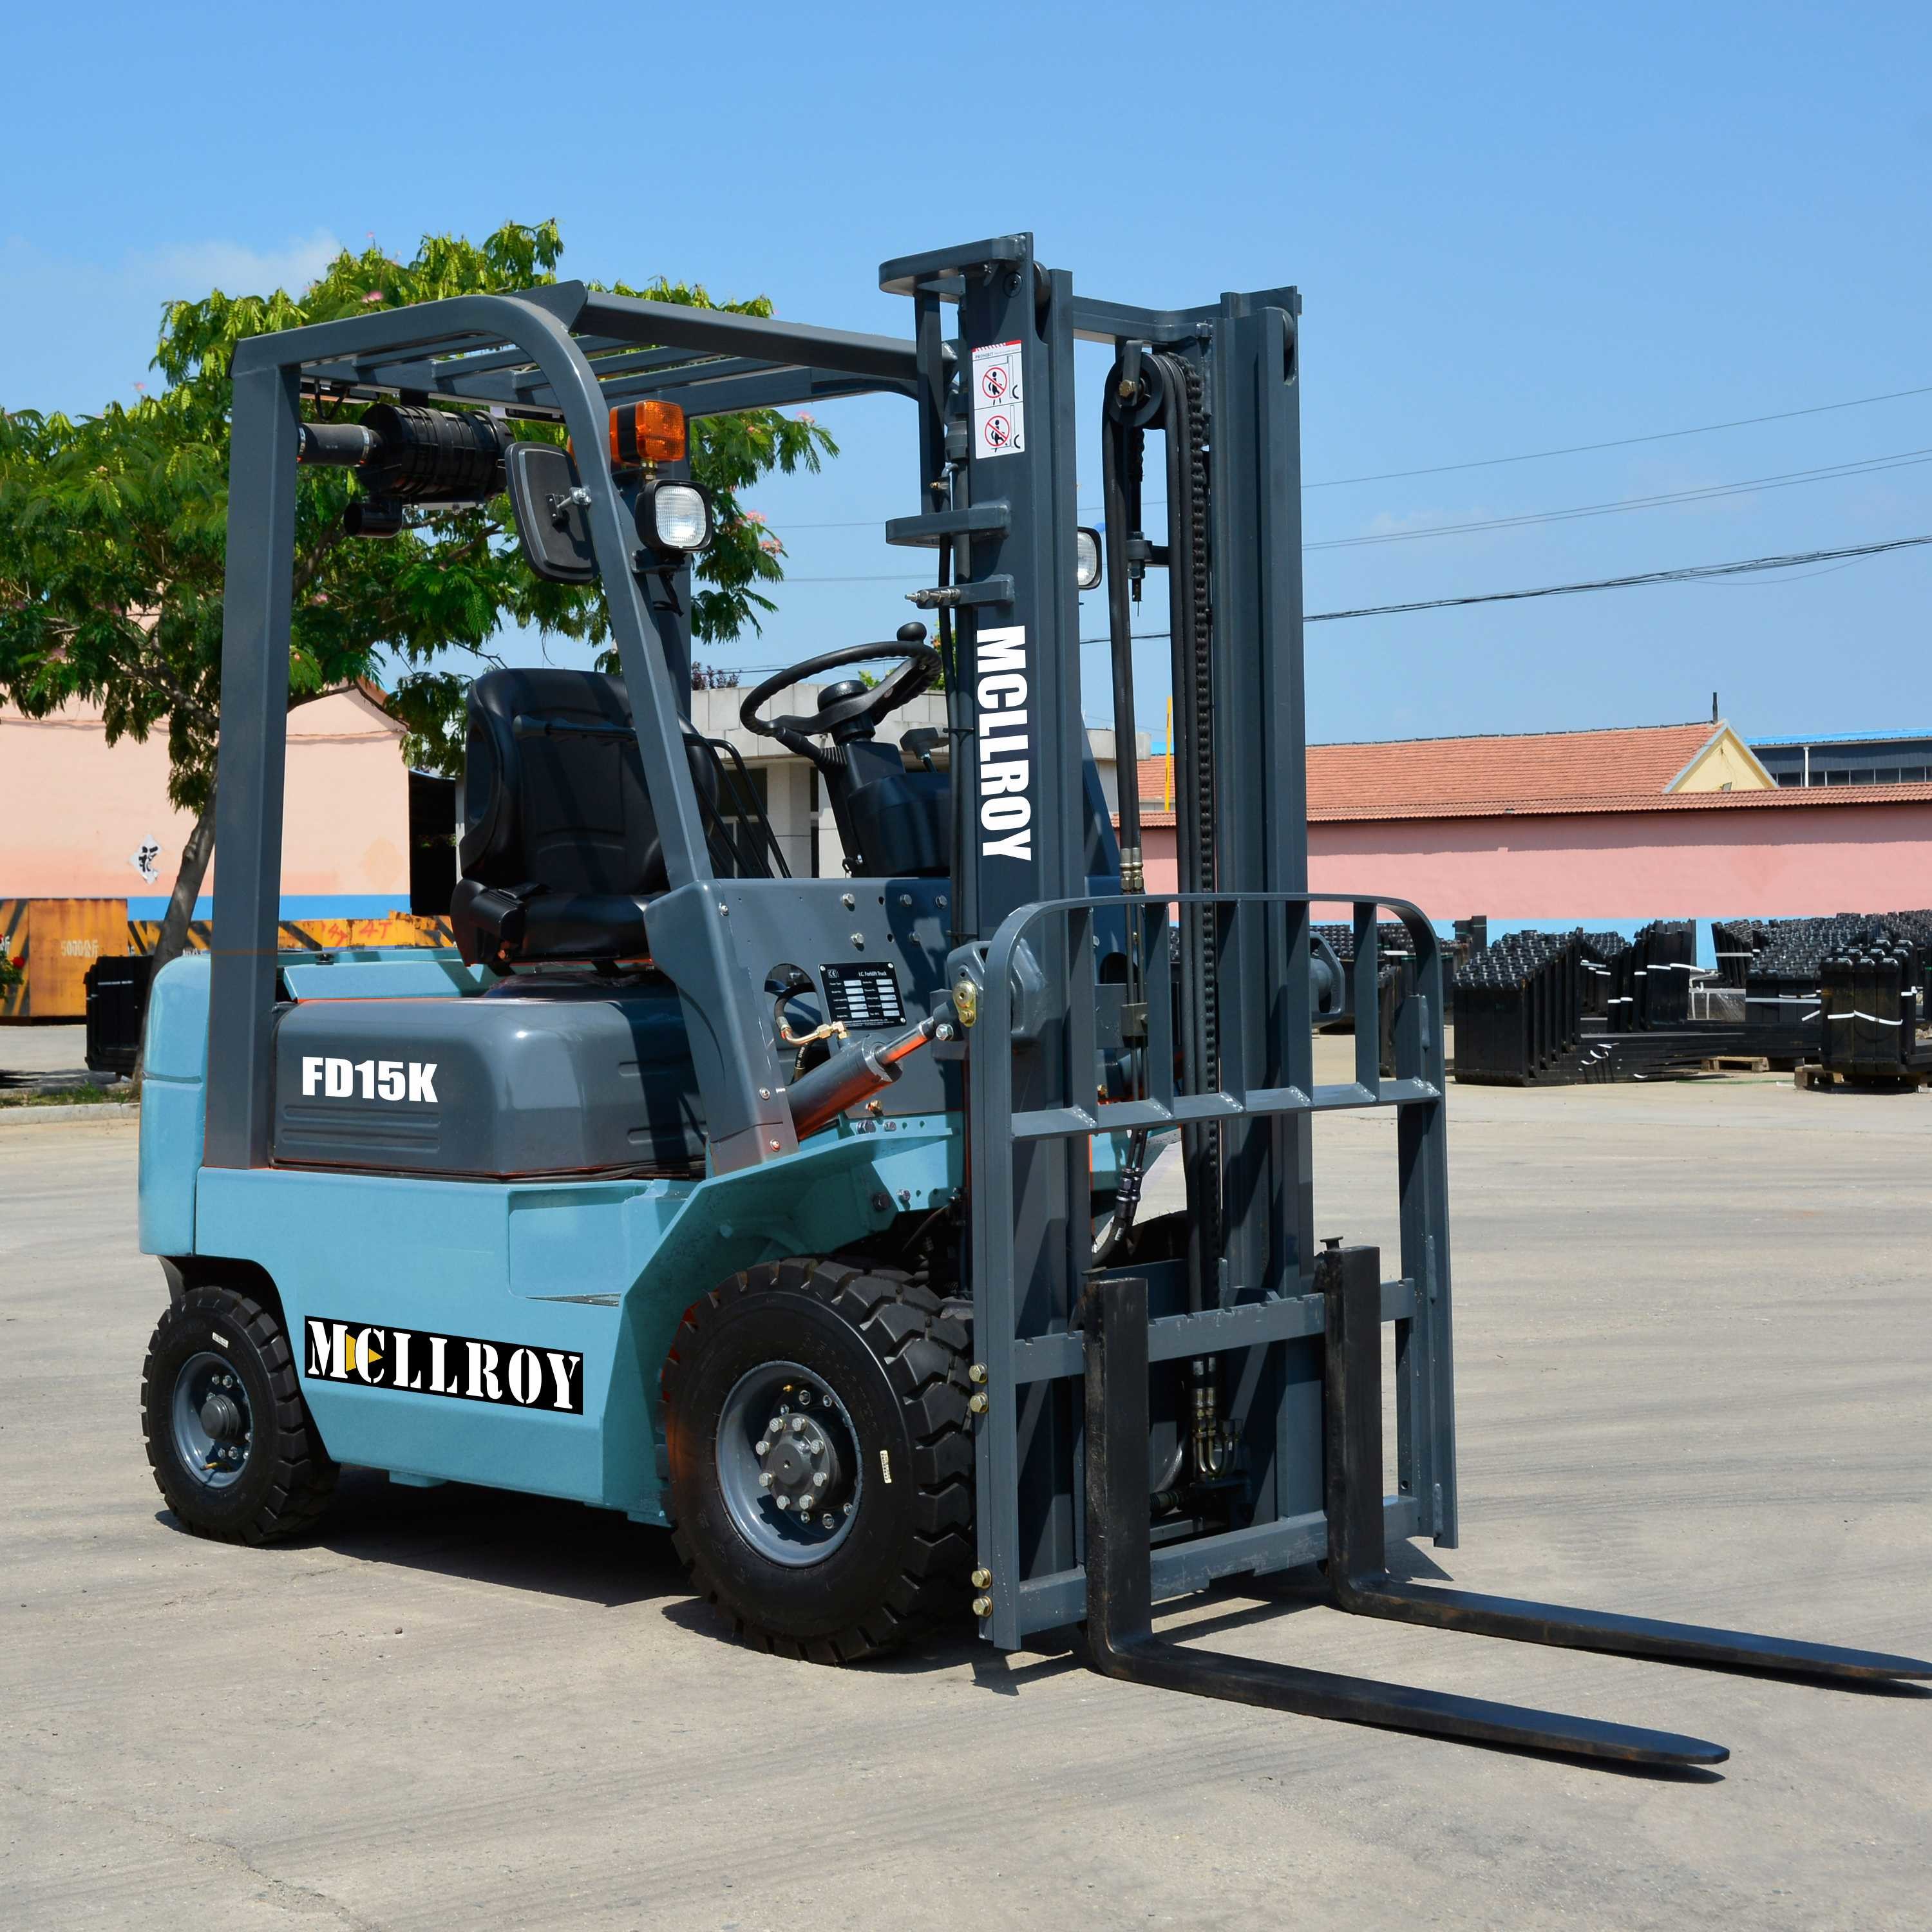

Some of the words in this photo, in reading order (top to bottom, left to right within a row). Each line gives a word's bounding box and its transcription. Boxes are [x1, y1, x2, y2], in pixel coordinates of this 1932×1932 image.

[977, 625, 1031, 861] MCLLROY
[302, 1056, 439, 1103] FD15K
[308, 1320, 580, 1410] MCLLROY
